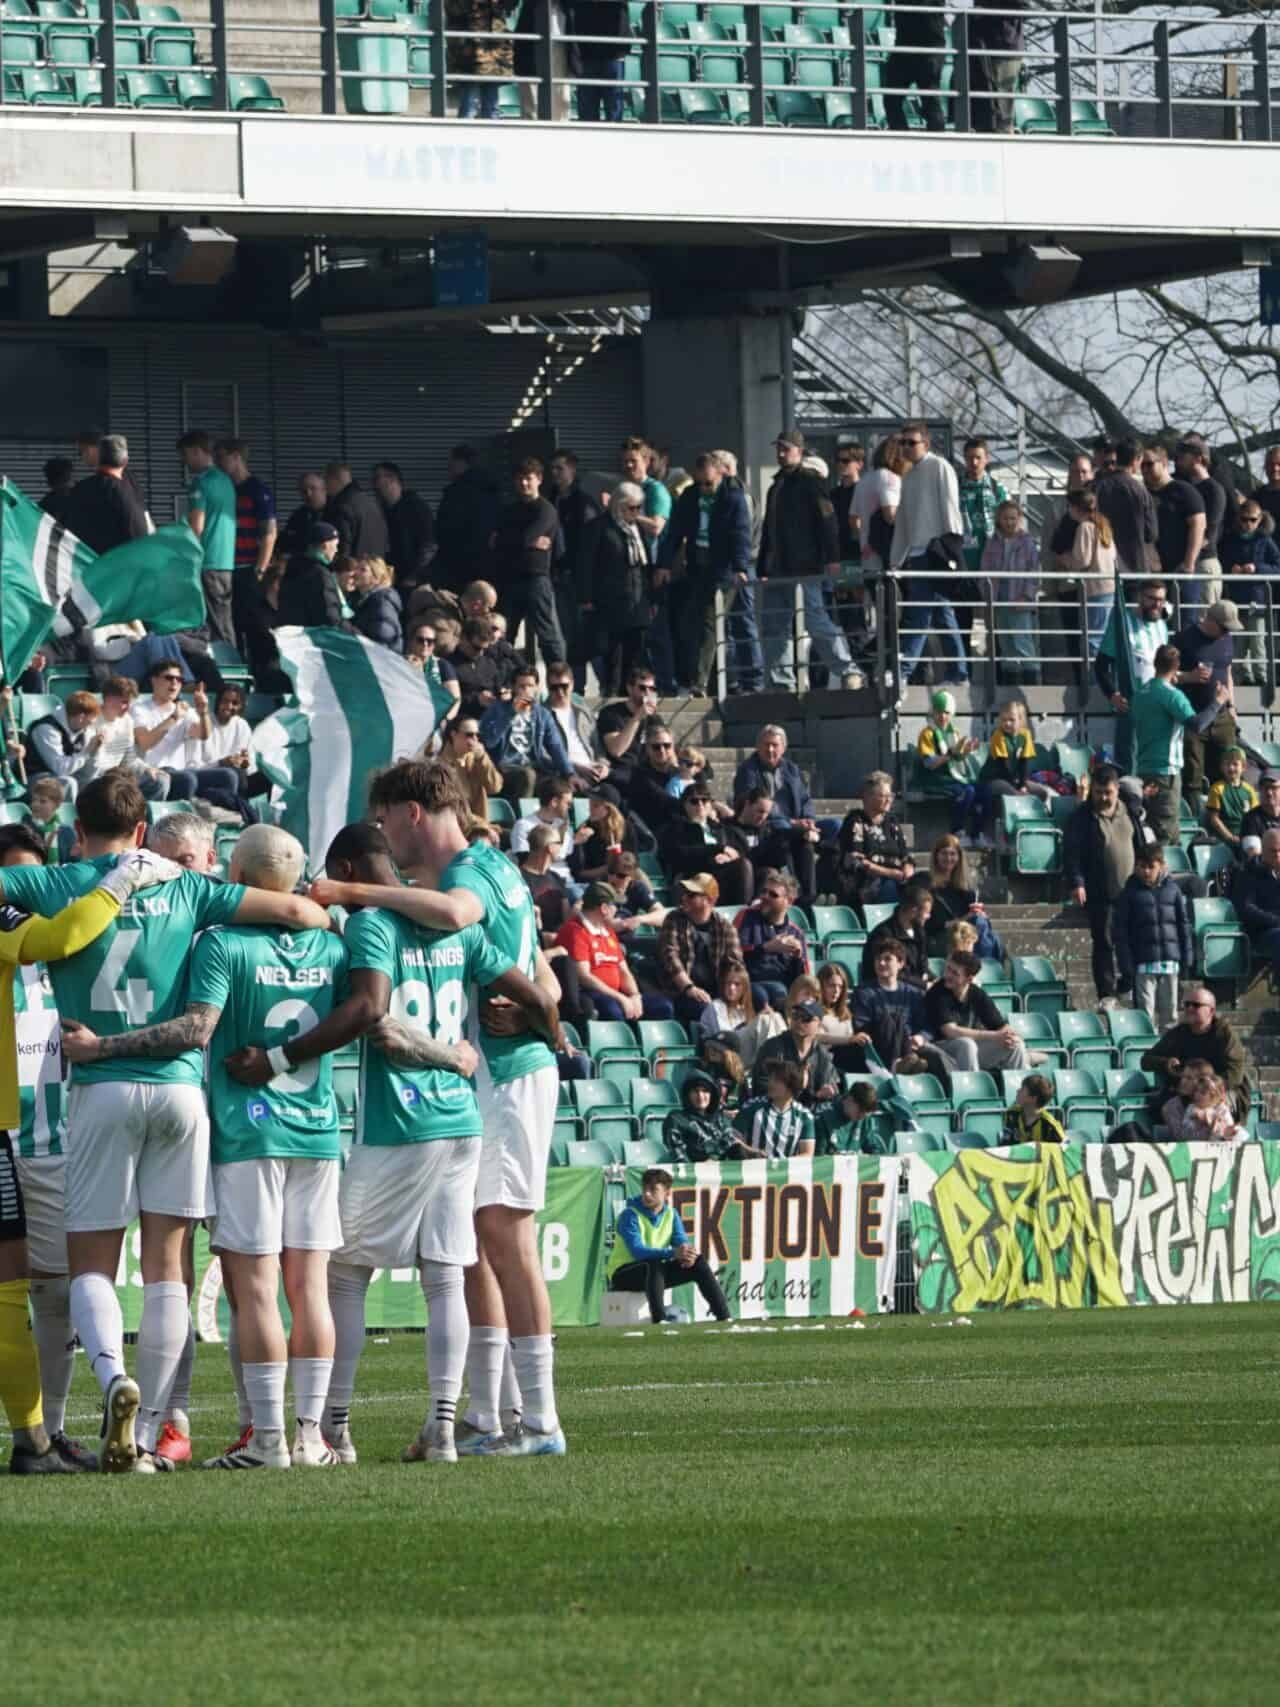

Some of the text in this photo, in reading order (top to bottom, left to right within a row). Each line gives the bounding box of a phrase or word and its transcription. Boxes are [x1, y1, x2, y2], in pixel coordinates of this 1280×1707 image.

[90, 928, 154, 1025] 4
[255, 966, 333, 987] NIELSEN
[672, 1182, 886, 1262] EKTION E
